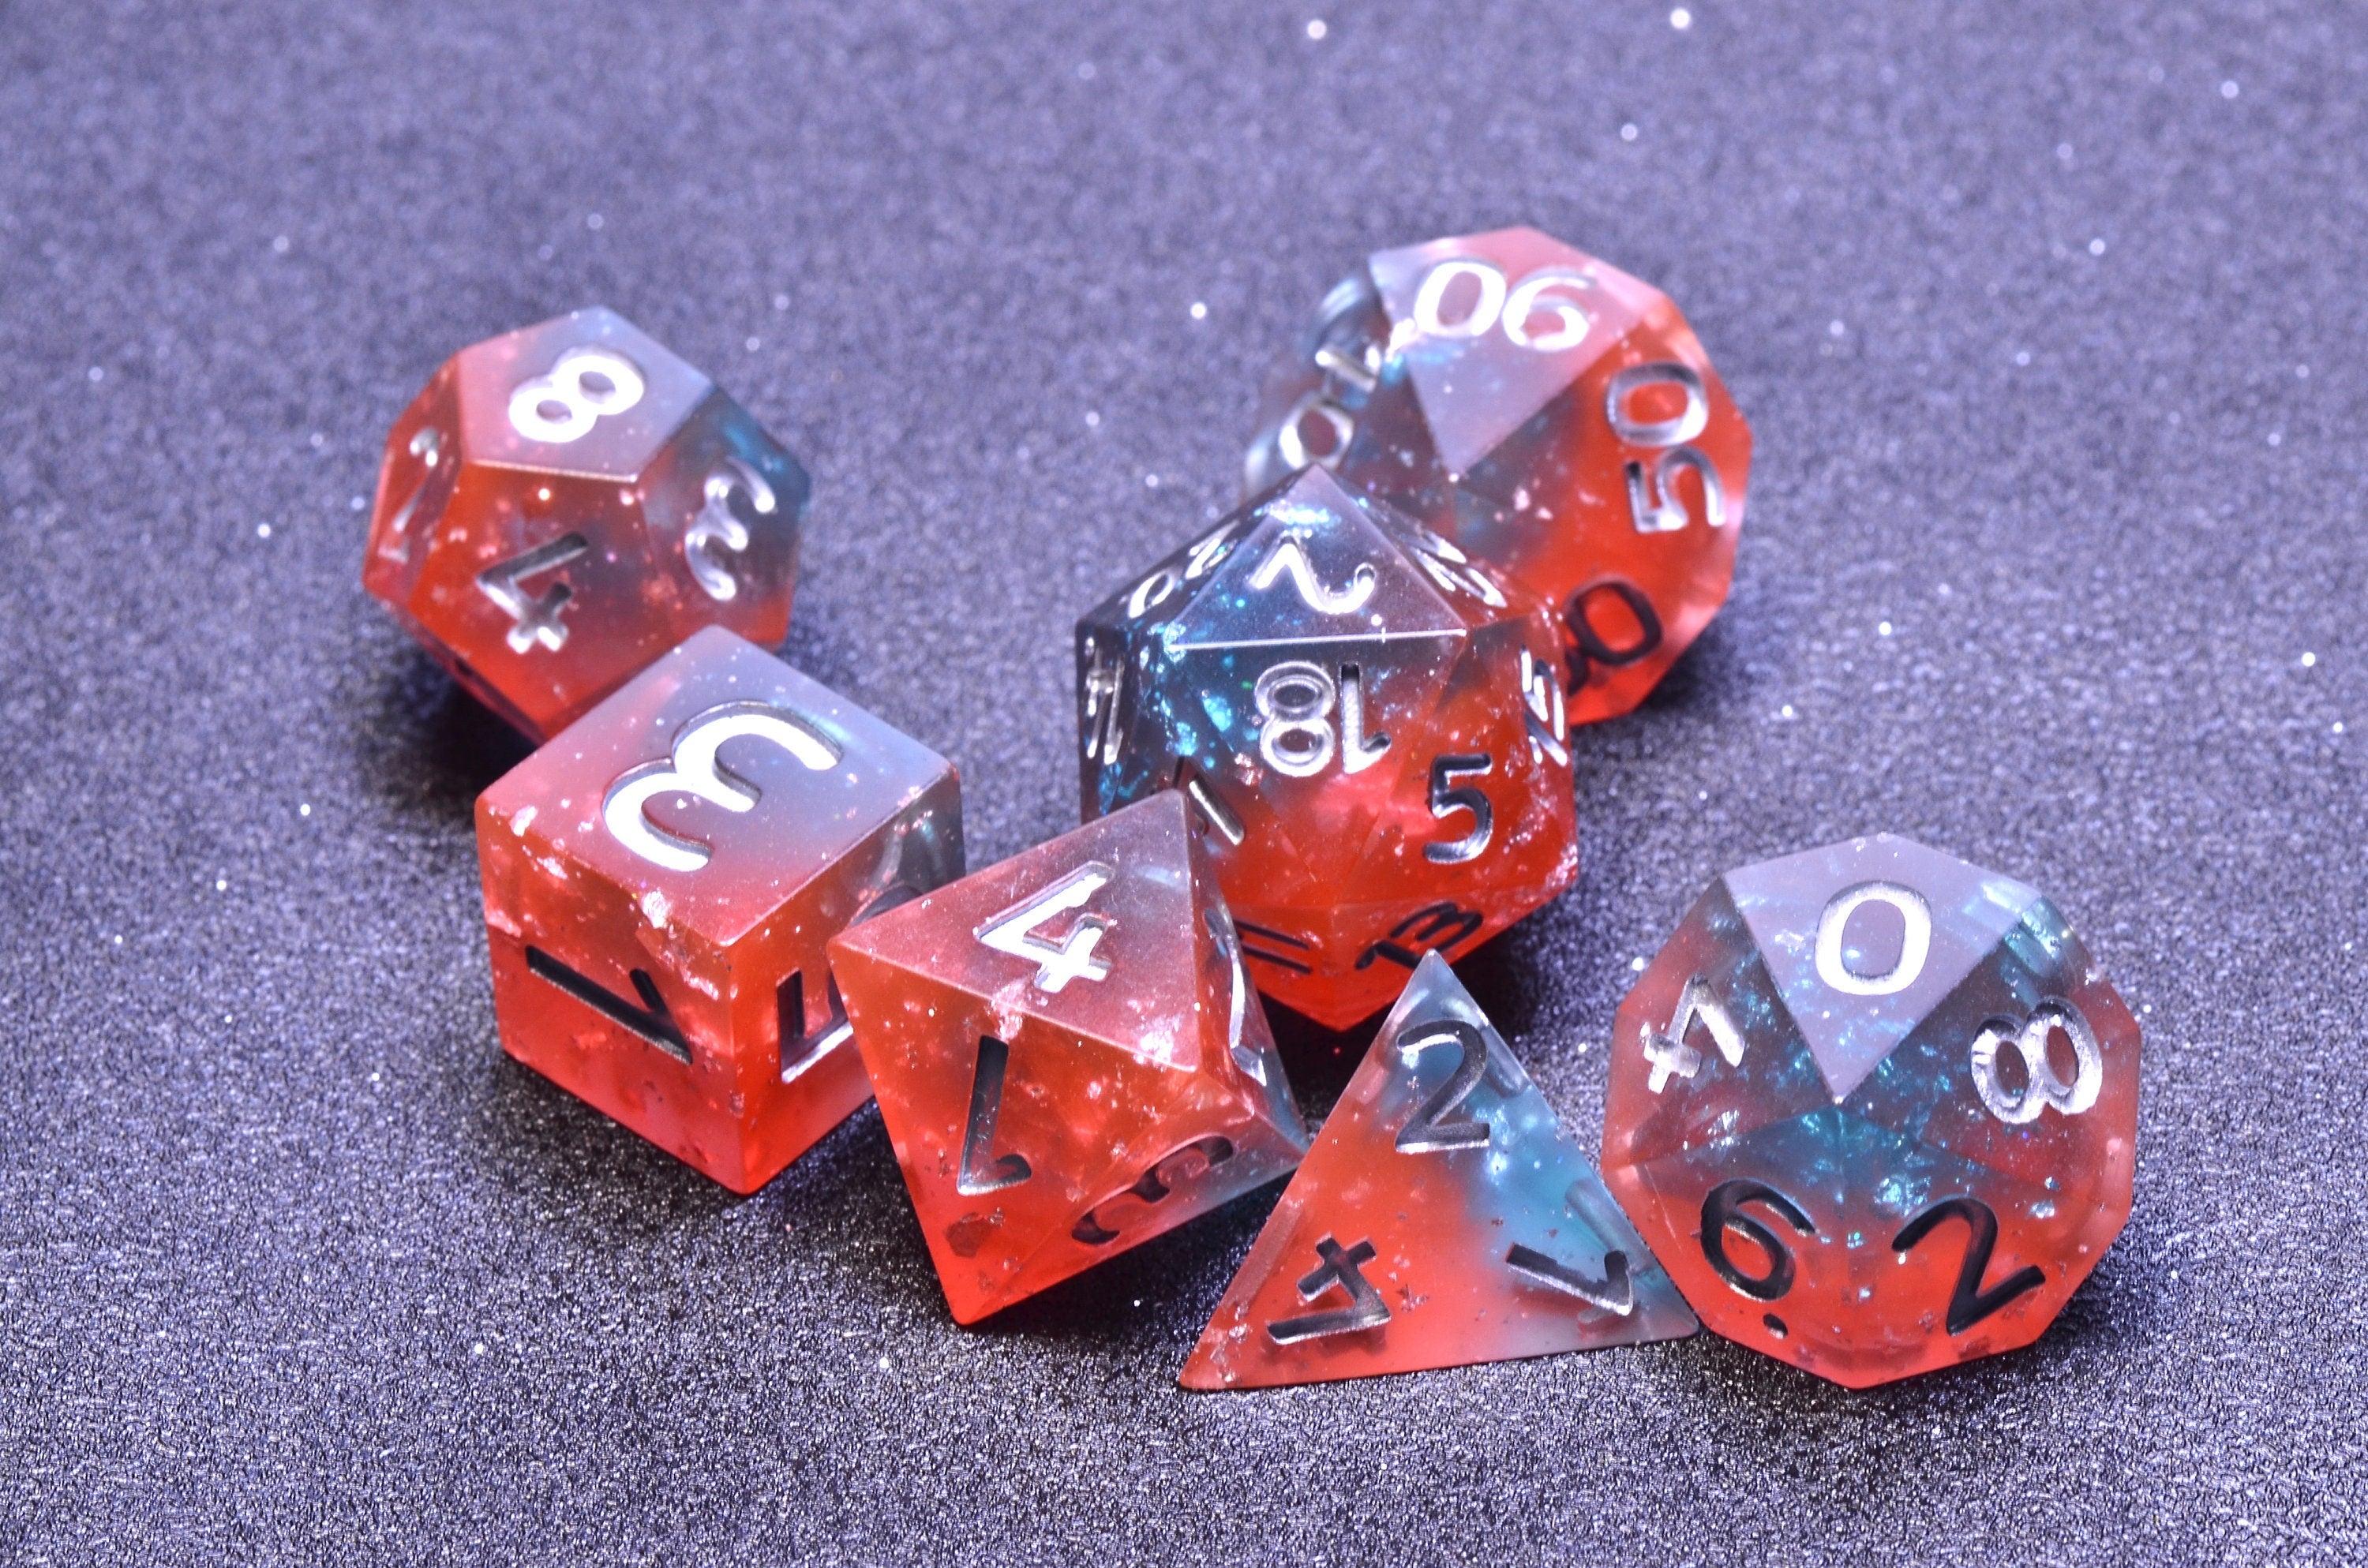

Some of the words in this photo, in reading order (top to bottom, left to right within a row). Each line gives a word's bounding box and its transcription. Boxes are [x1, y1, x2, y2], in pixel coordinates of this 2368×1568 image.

[508, 346, 646, 443] 8
[685, 456, 776, 602] 3
[1249, 534, 1378, 616] 2
[477, 532, 589, 654] 4
[1254, 661, 1392, 777] 18
[601, 700, 843, 872] 3
[1423, 752, 1494, 864] 5
[972, 860, 1112, 994] 4
[1815, 880, 1933, 997] 0
[526, 945, 693, 1065] 1
[1640, 971, 1746, 1095] 4
[1970, 997, 2104, 1125] 8
[1396, 1020, 1491, 1154] 2
[1267, 1233, 1392, 1346] 4
[1892, 1197, 2046, 1338] 2
